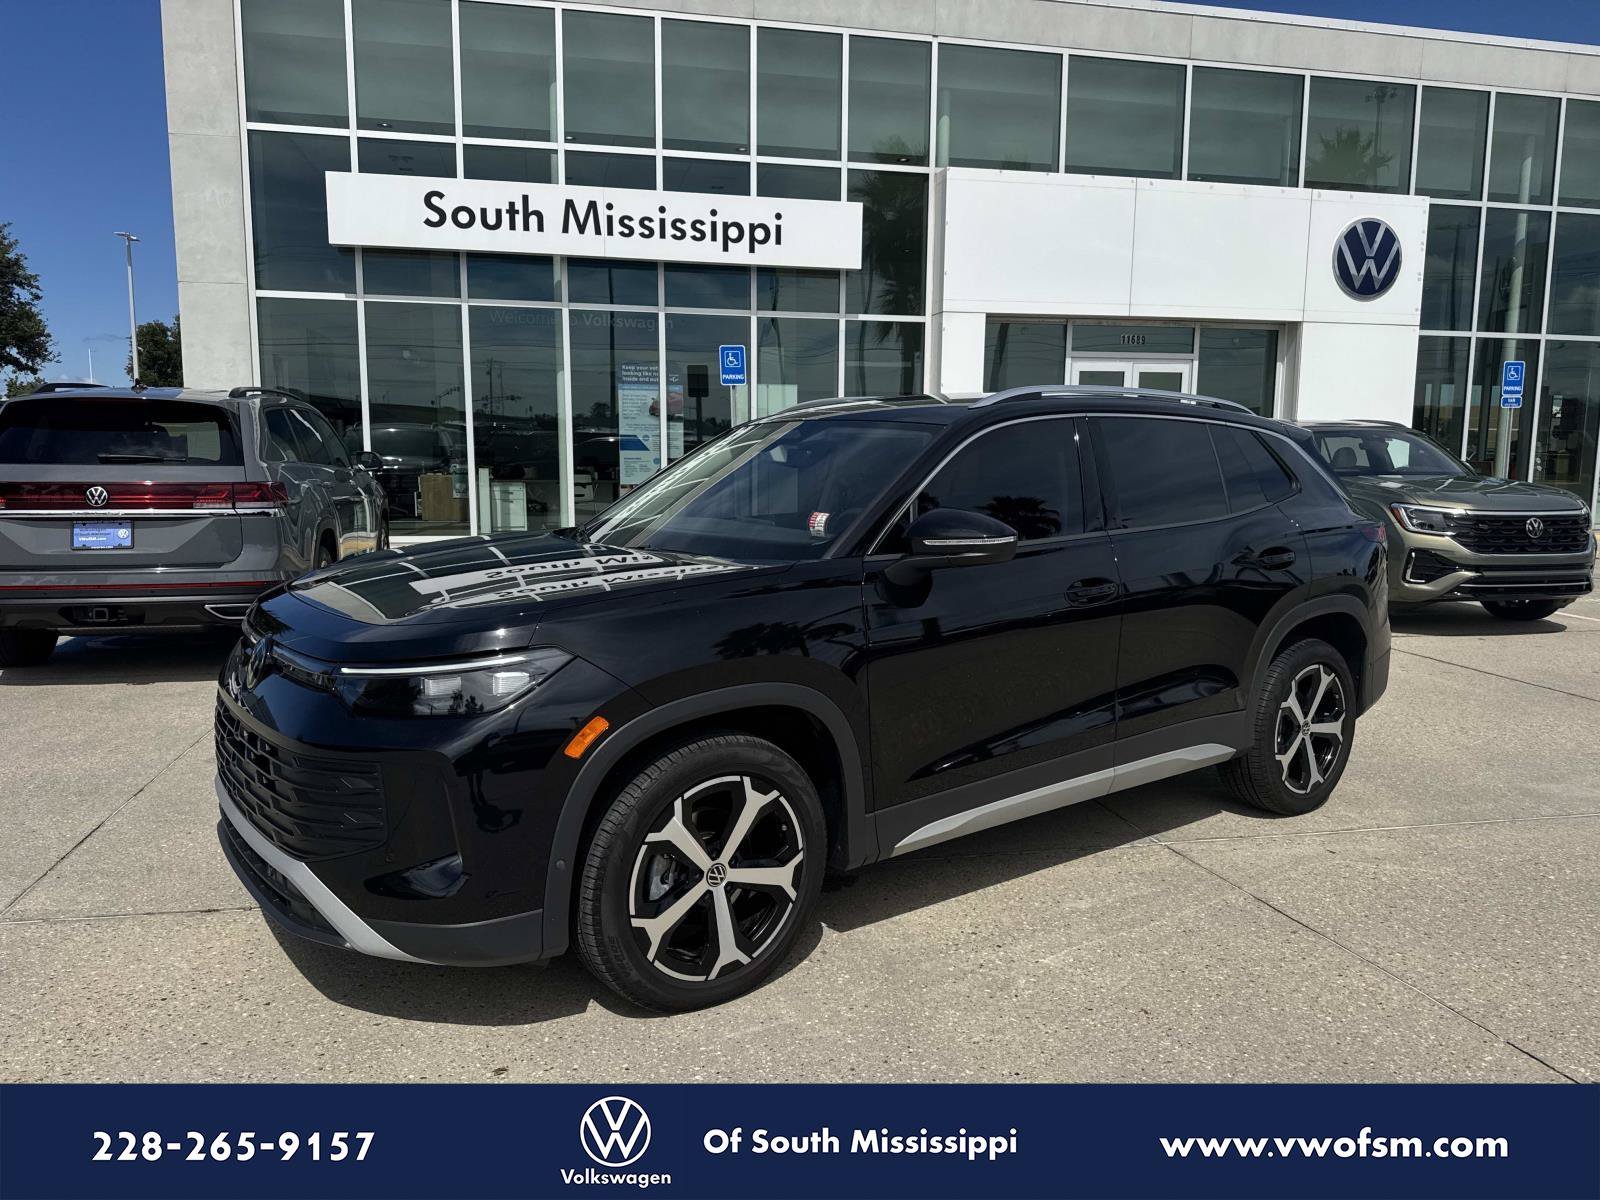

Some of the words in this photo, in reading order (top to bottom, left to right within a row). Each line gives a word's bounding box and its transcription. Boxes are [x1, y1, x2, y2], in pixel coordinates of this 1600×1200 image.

[423, 190, 545, 232] South
[561, 199, 783, 253] Mississippi
[582, 313, 674, 331] Volswagn
